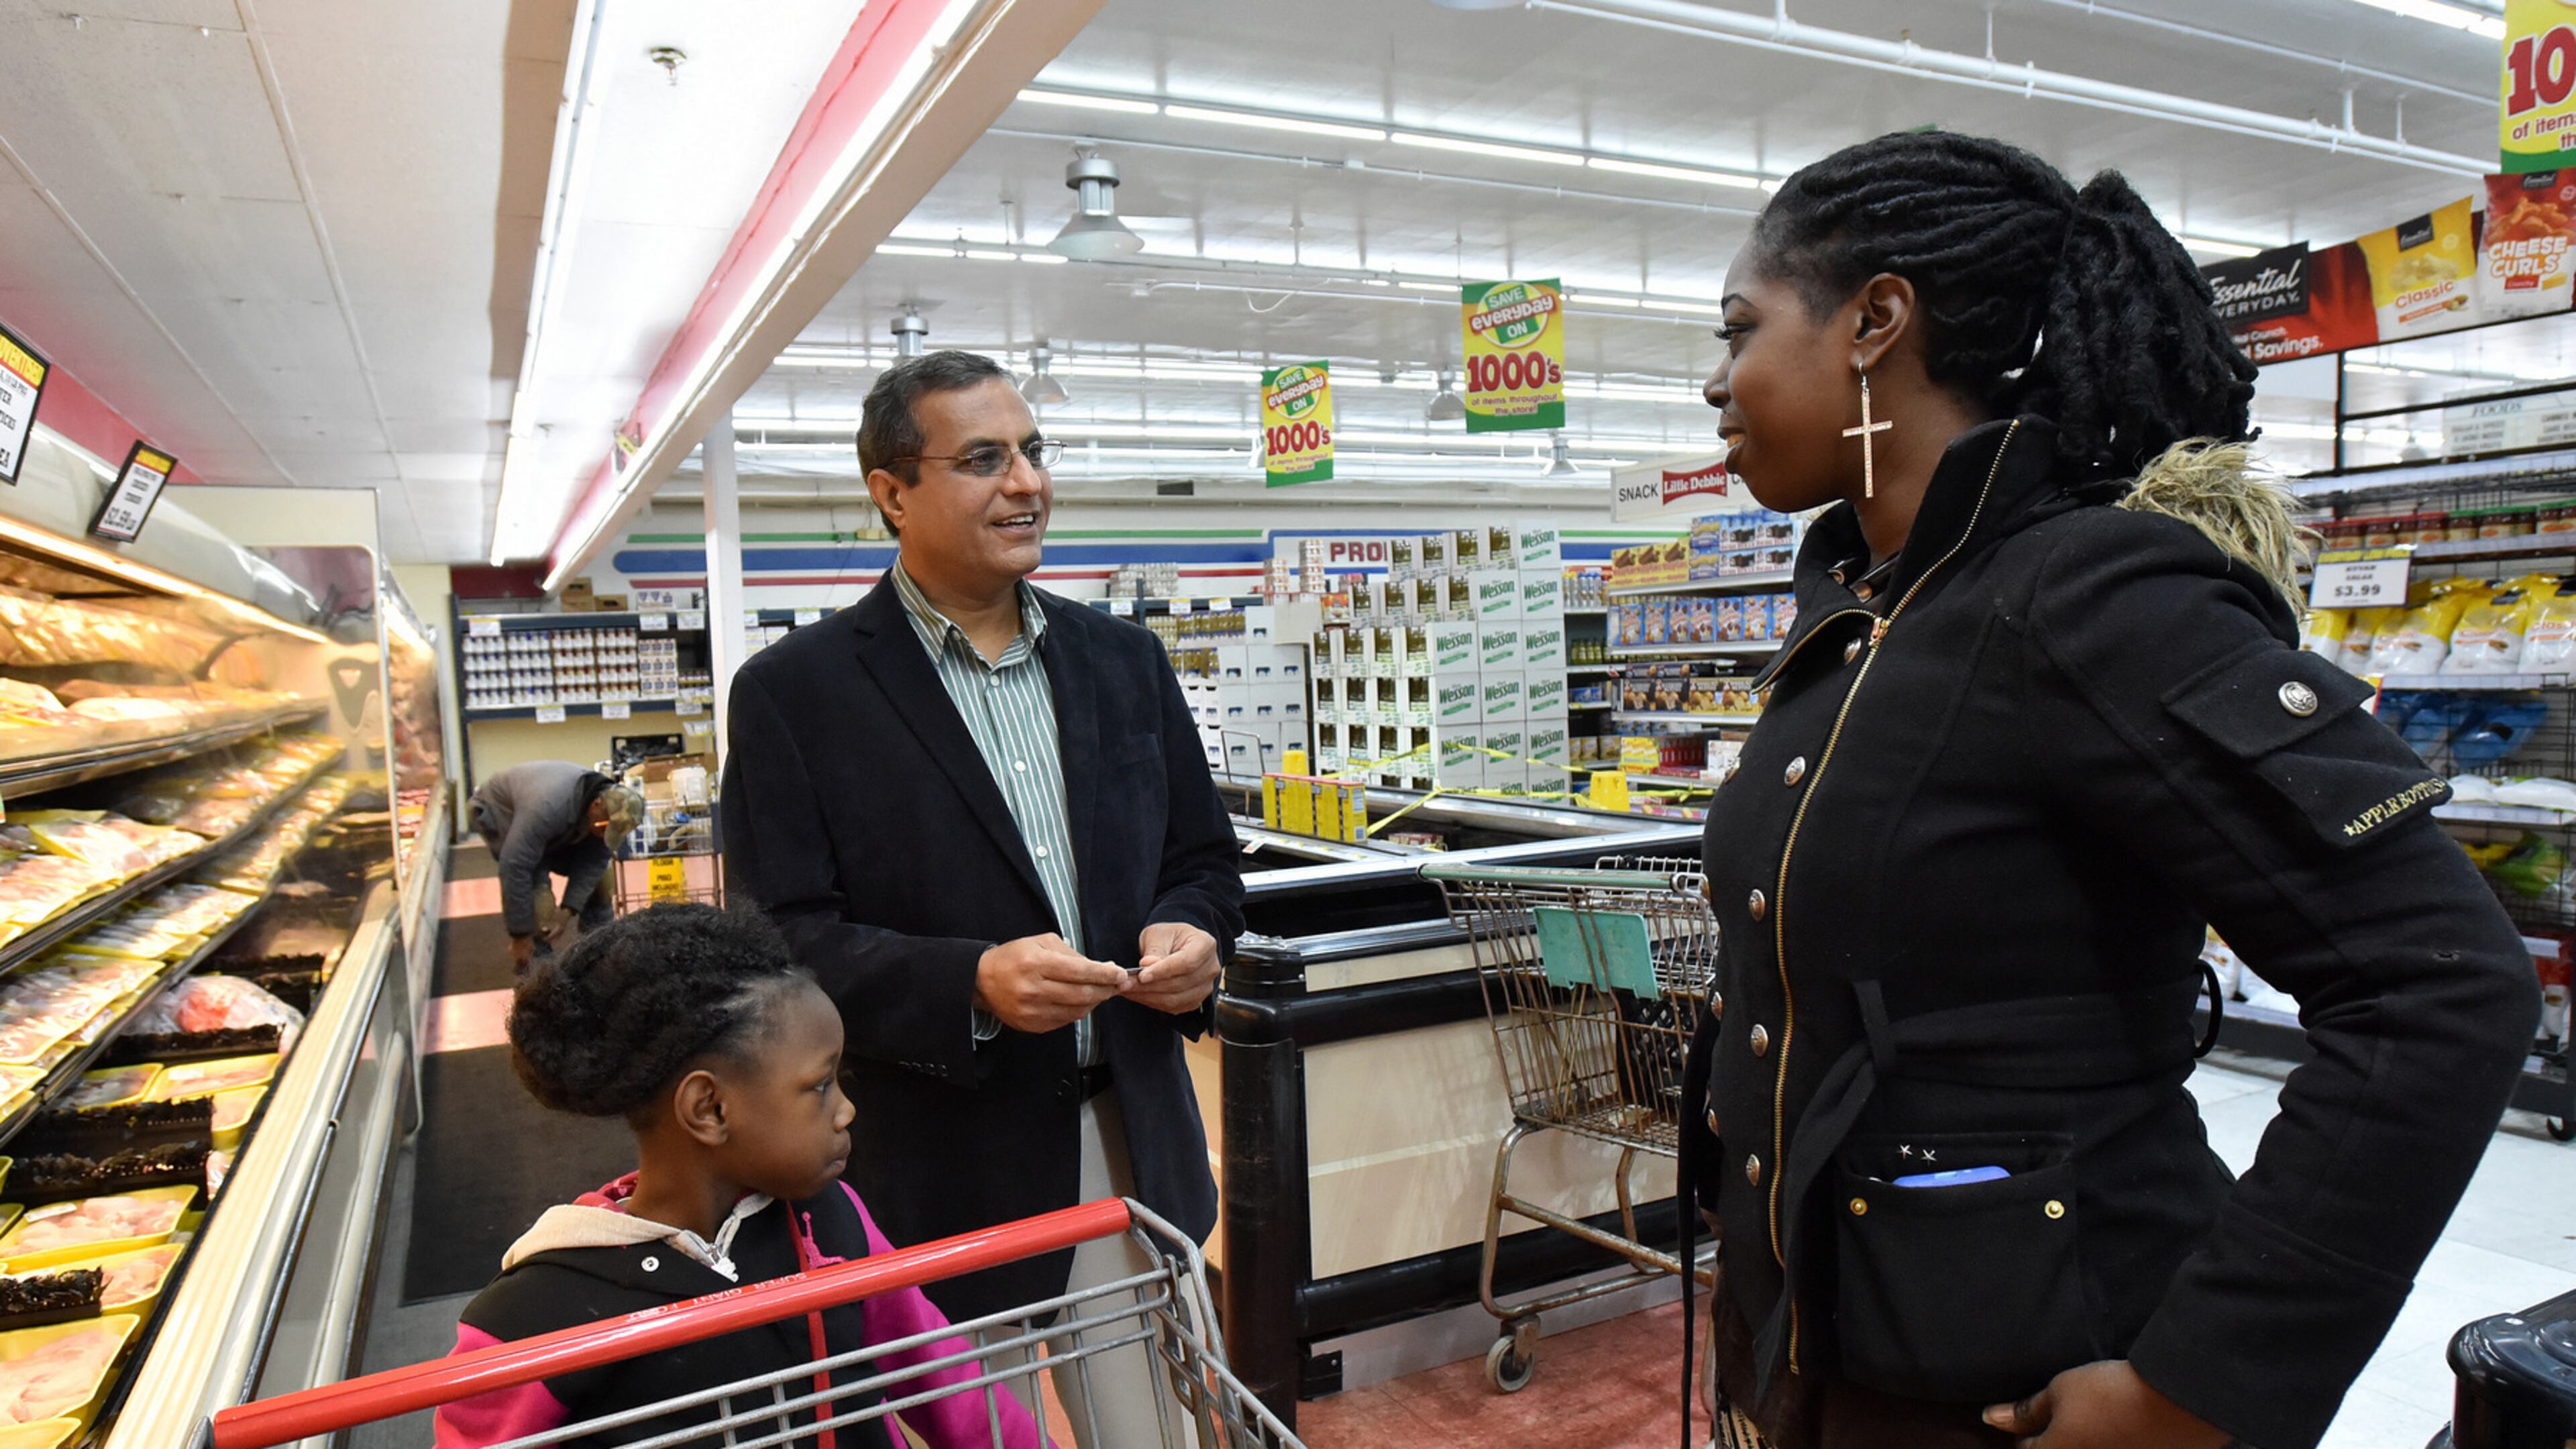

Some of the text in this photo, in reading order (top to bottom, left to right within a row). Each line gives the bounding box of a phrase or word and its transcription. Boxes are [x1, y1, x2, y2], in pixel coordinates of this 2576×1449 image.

[2513, 122, 2528, 140] of
[2489, 236, 2567, 260] CHEESE
[2492, 254, 2559, 277] CURLS
[2209, 258, 2302, 307] Essential
[1488, 286, 1524, 308] SAVE
[2216, 291, 2299, 318] VERYDAY
[2395, 281, 2454, 309] Classic
[1507, 321, 1528, 338] ON
[1279, 370, 1303, 389] SAVE
[1467, 351, 1562, 393] 1000's
[1292, 397, 1307, 411] ON
[1509, 393, 1557, 404] throughout
[1267, 420, 1331, 457] 1000's
[1619, 483, 1659, 502] SNACK
[1664, 478, 1689, 495] Little
[1690, 472, 1725, 490] Debbie
[1520, 530, 1555, 549] Wesson
[1330, 541, 1388, 562] PRO
[1479, 580, 1515, 600] Wesson
[1523, 581, 1558, 600] Wesson
[2334, 584, 2381, 597] $3.99
[1436, 633, 1472, 651] Wesson
[1482, 631, 1517, 651] Wesson
[1526, 631, 1560, 650] Wesson
[1439, 684, 1474, 704] Wesson
[1485, 682, 1519, 702] Wesson
[1529, 680, 1563, 700] Wesson
[1487, 733, 1521, 751] Wesson
[1530, 730, 1564, 750] Wesson
[2352, 797, 2402, 835] APPLE
[752, 1272, 808, 1290] SUPER
[693, 1287, 743, 1304] GIANT
